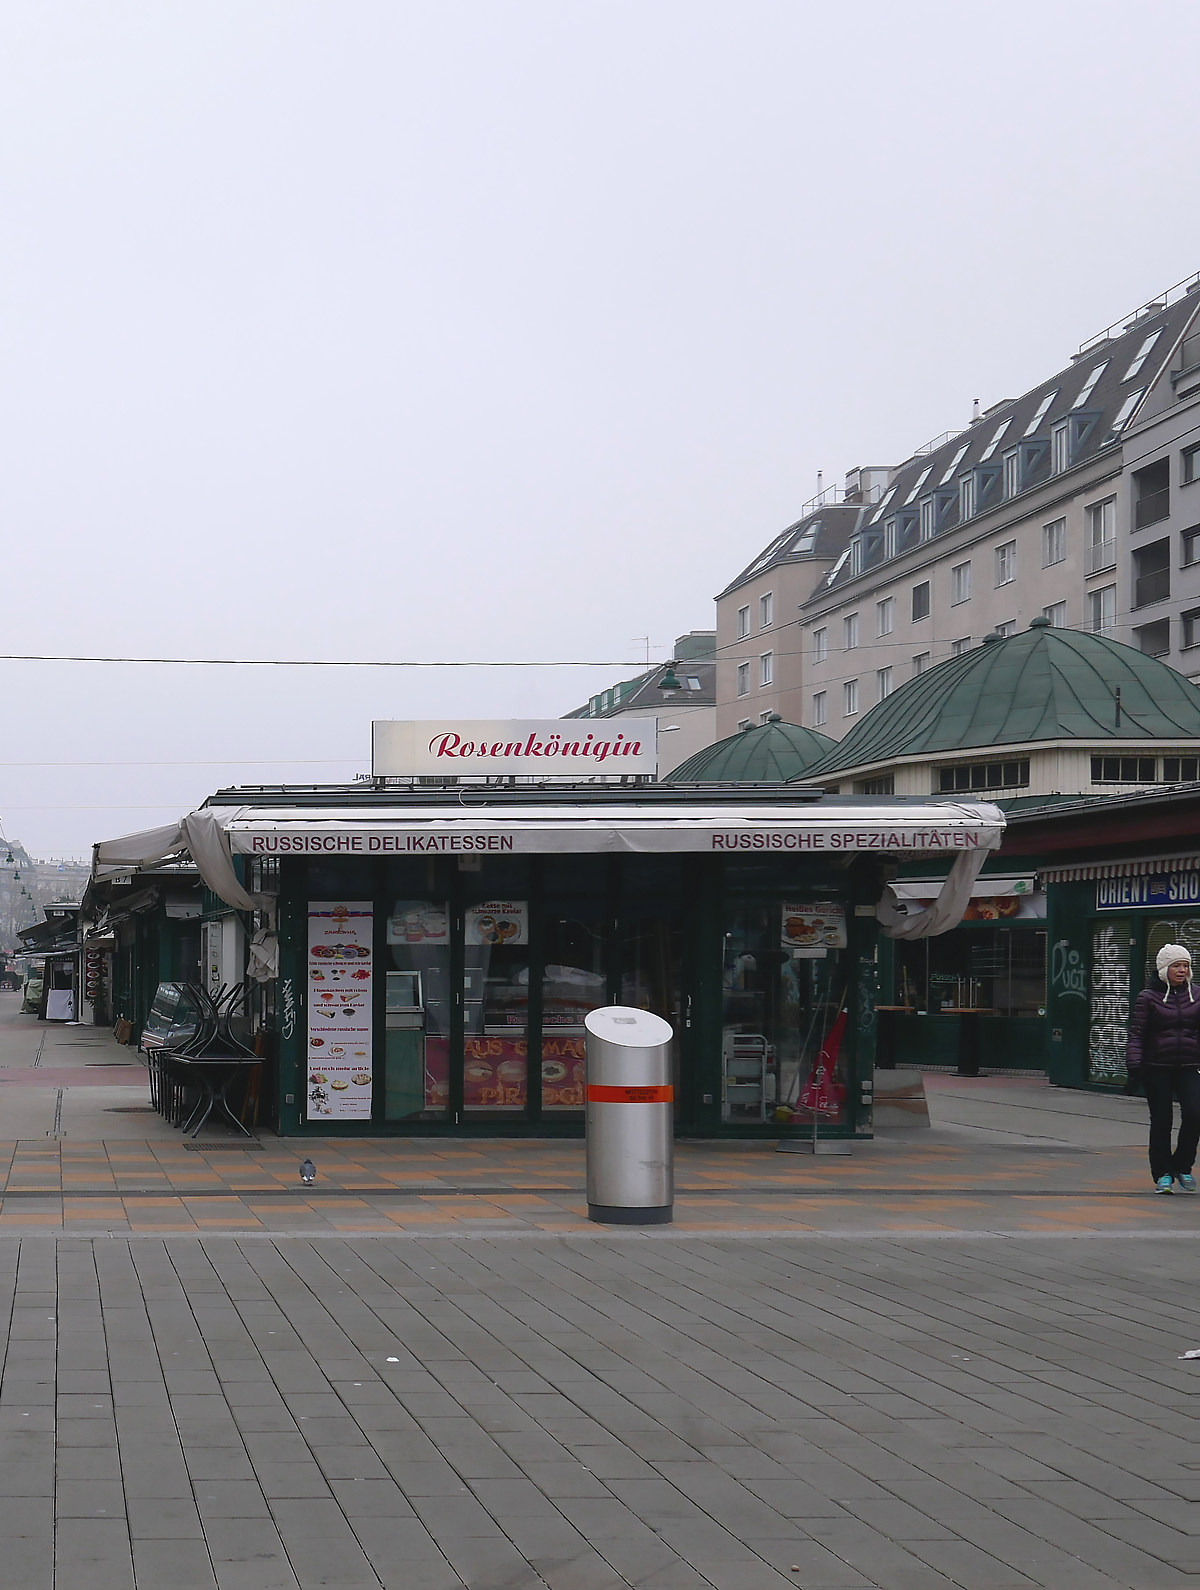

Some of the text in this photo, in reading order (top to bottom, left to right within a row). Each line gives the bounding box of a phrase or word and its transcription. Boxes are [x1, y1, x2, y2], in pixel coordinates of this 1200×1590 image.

[428, 731, 644, 764] Rosenkönigin
[252, 835, 514, 851] RUSSISCHE DELIKATESSEN
[711, 829, 979, 849] RUSSISCHE SPEZIALITÄTEN
[1099, 876, 1150, 904] ORIENT
